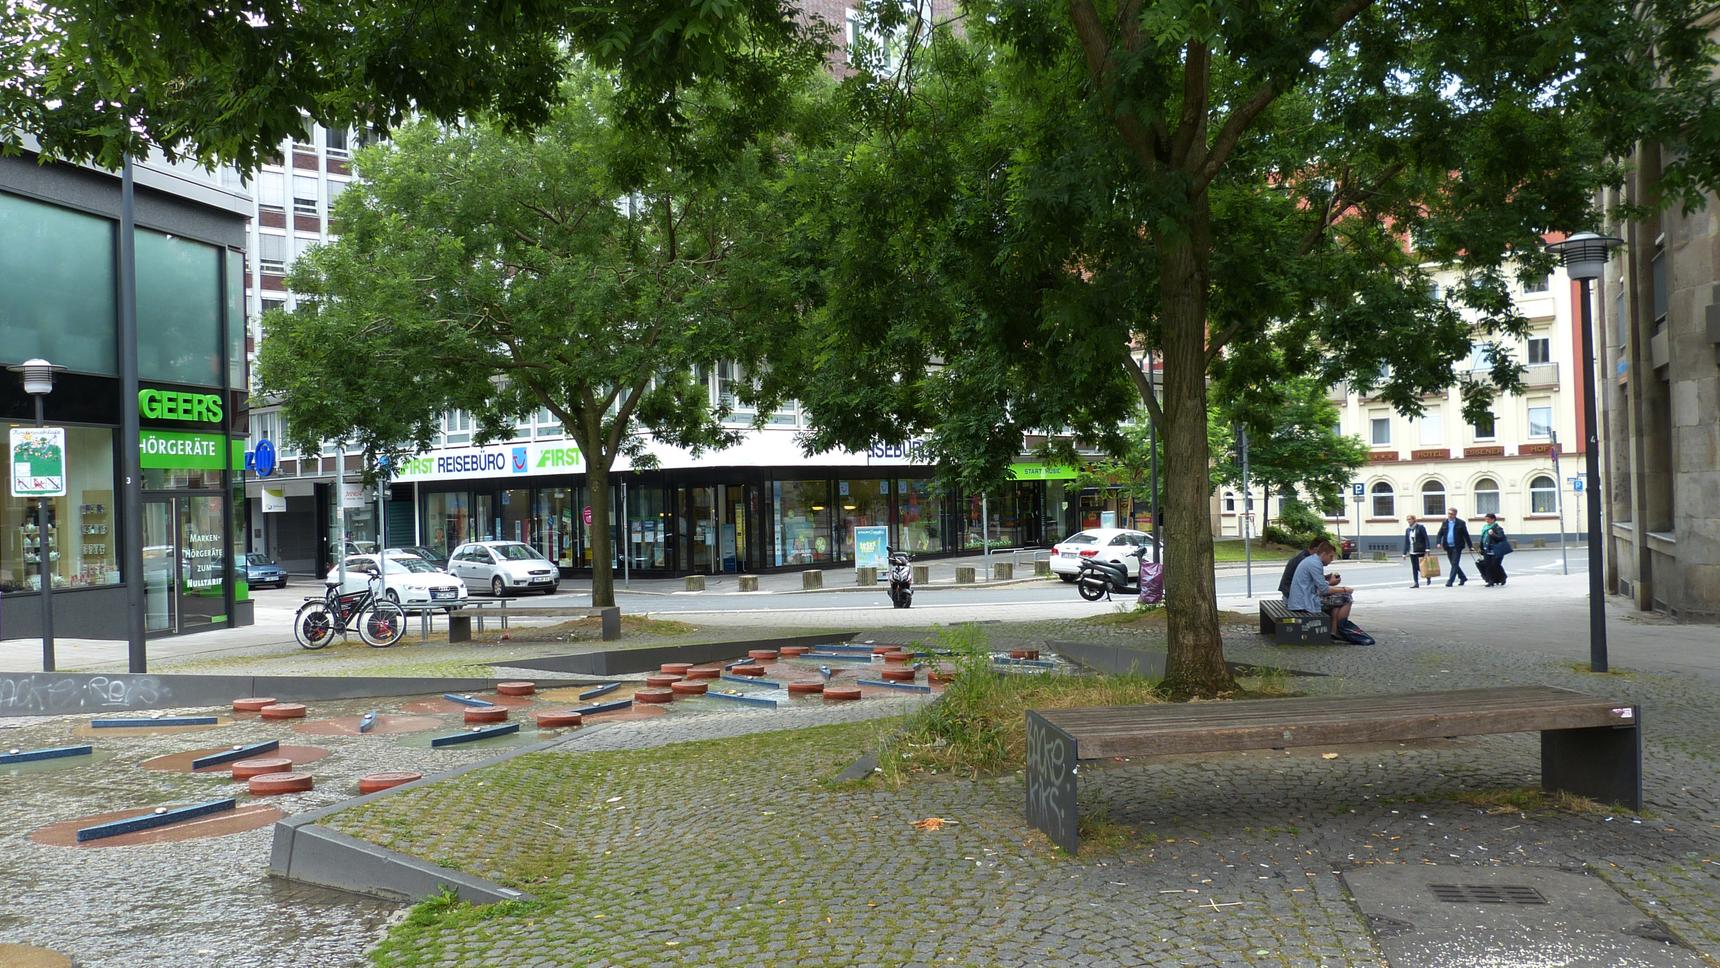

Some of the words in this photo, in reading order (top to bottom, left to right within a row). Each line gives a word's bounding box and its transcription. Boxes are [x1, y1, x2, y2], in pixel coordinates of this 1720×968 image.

[138, 388, 223, 423] GEERS
[139, 435, 216, 456] HÖRGERÄTE
[1417, 450, 1443, 458] HOTEL
[1464, 446, 1503, 456] ESSENER
[1530, 445, 1549, 453] HOF
[438, 450, 505, 473] REISEBÜRO
[536, 447, 580, 468] FIRST
[1355, 484, 1363, 494] P
[184, 547, 223, 558] HÖRGERÄTE
[197, 564, 212, 572] ZUM
[187, 578, 223, 588] NULLTARIF
